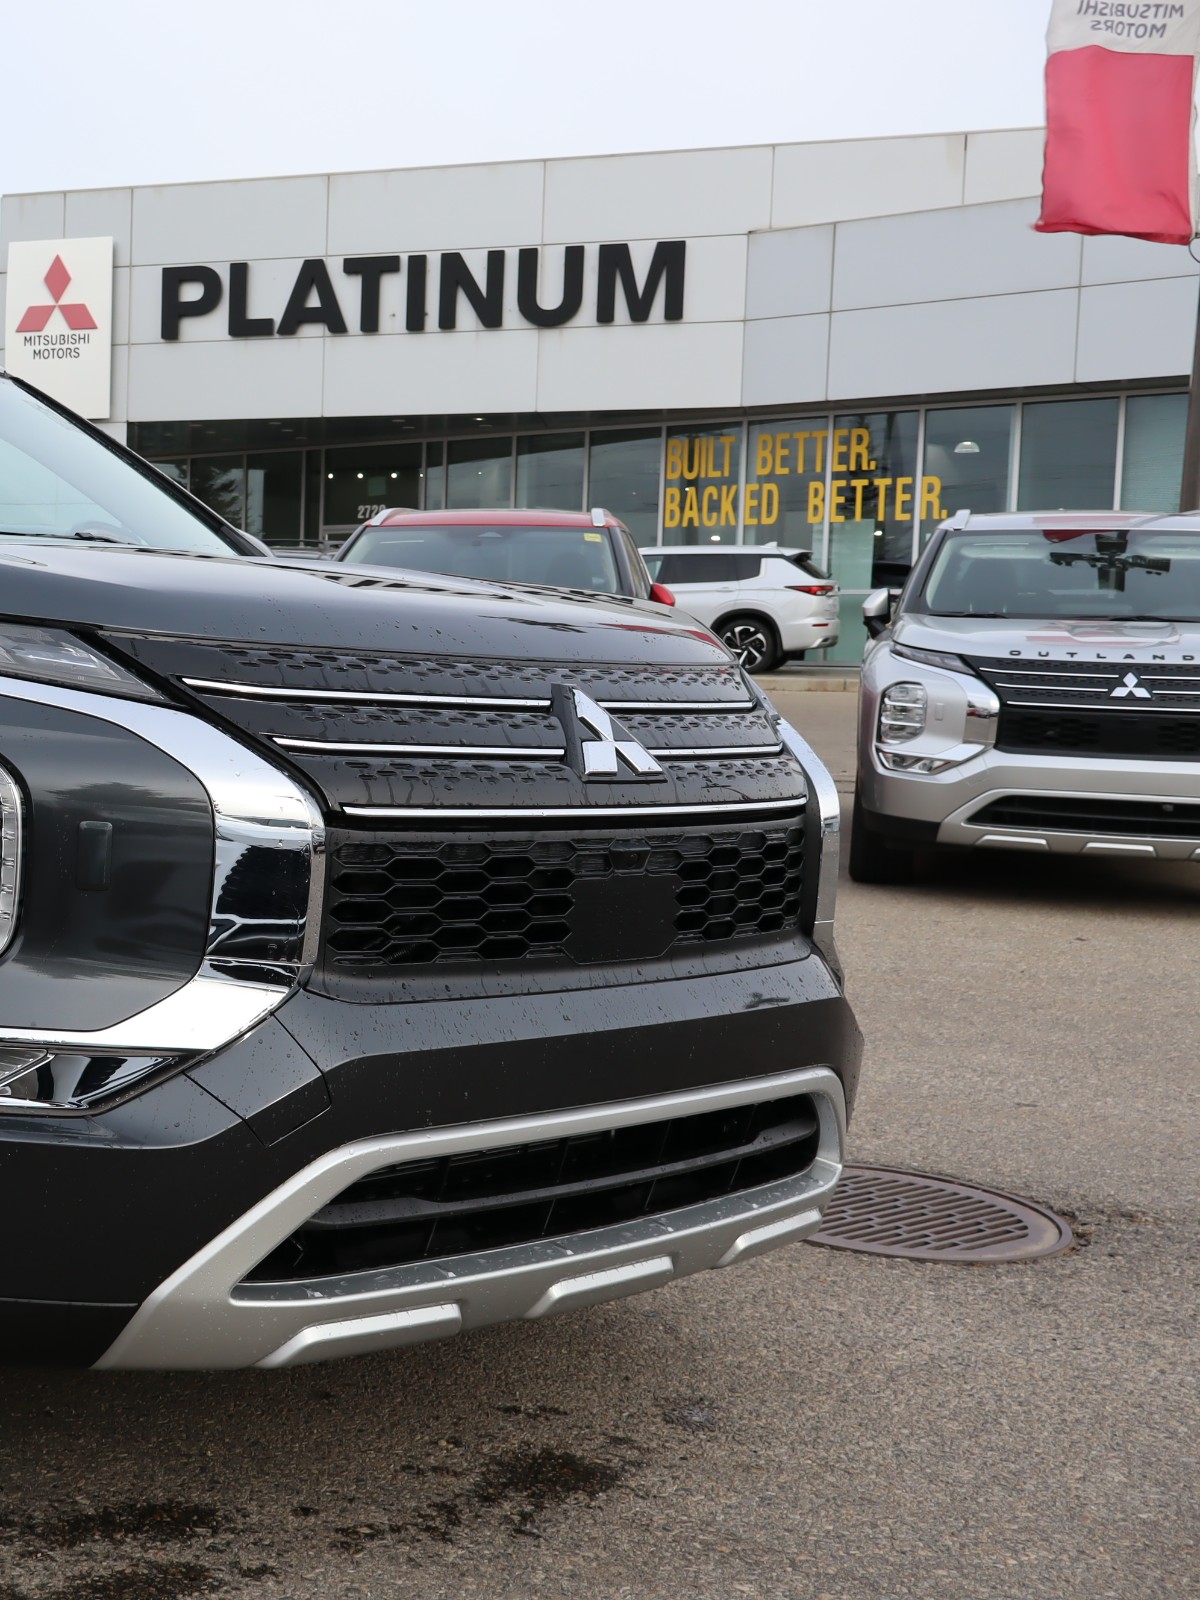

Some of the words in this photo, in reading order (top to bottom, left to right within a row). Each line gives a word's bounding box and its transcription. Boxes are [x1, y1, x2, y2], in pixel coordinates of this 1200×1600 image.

[161, 240, 686, 341] PLATINUM
[23, 333, 90, 347] MITSUBISHI
[33, 347, 80, 360] MOTORS
[665, 435, 736, 480] BUILT
[756, 427, 877, 476] BETTER.
[664, 483, 780, 528] BACKED
[807, 475, 948, 524] BETTER.
[1009, 649, 1196, 662] OUTLAND
